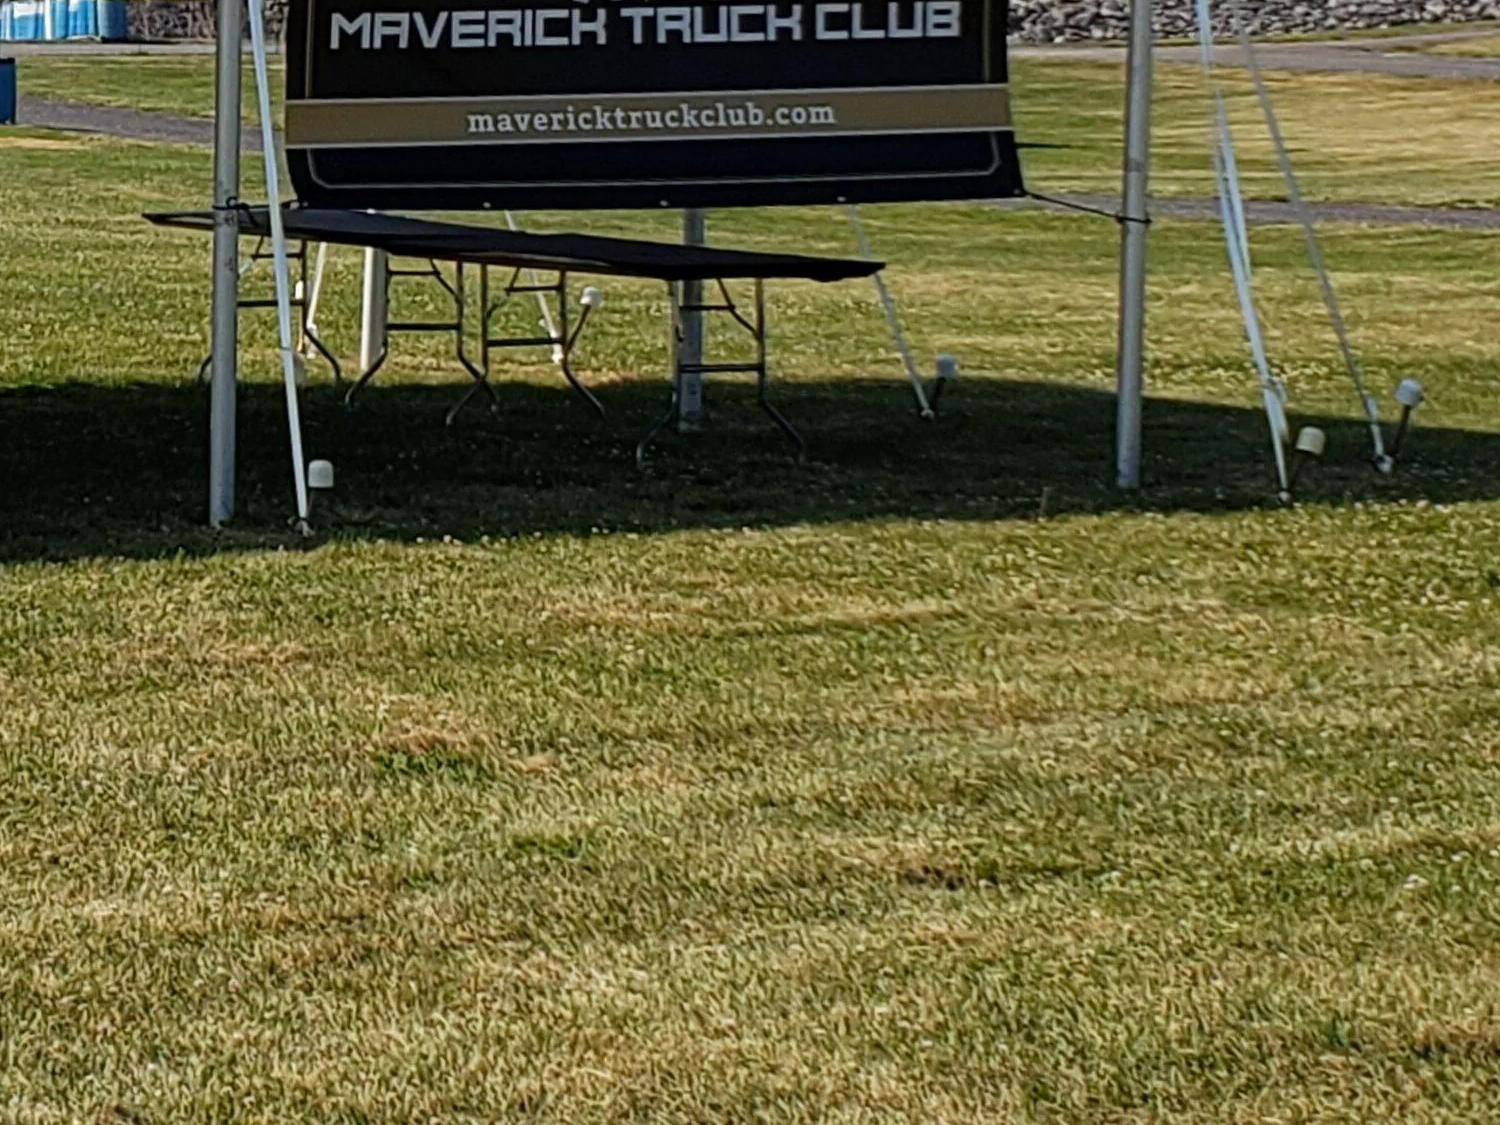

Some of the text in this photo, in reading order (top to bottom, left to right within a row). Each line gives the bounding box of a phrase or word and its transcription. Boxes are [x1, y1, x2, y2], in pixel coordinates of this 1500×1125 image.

[330, 0, 961, 50] MAVERICK TRUCK CLUB
[467, 102, 837, 134] mavericktruckclub.com
